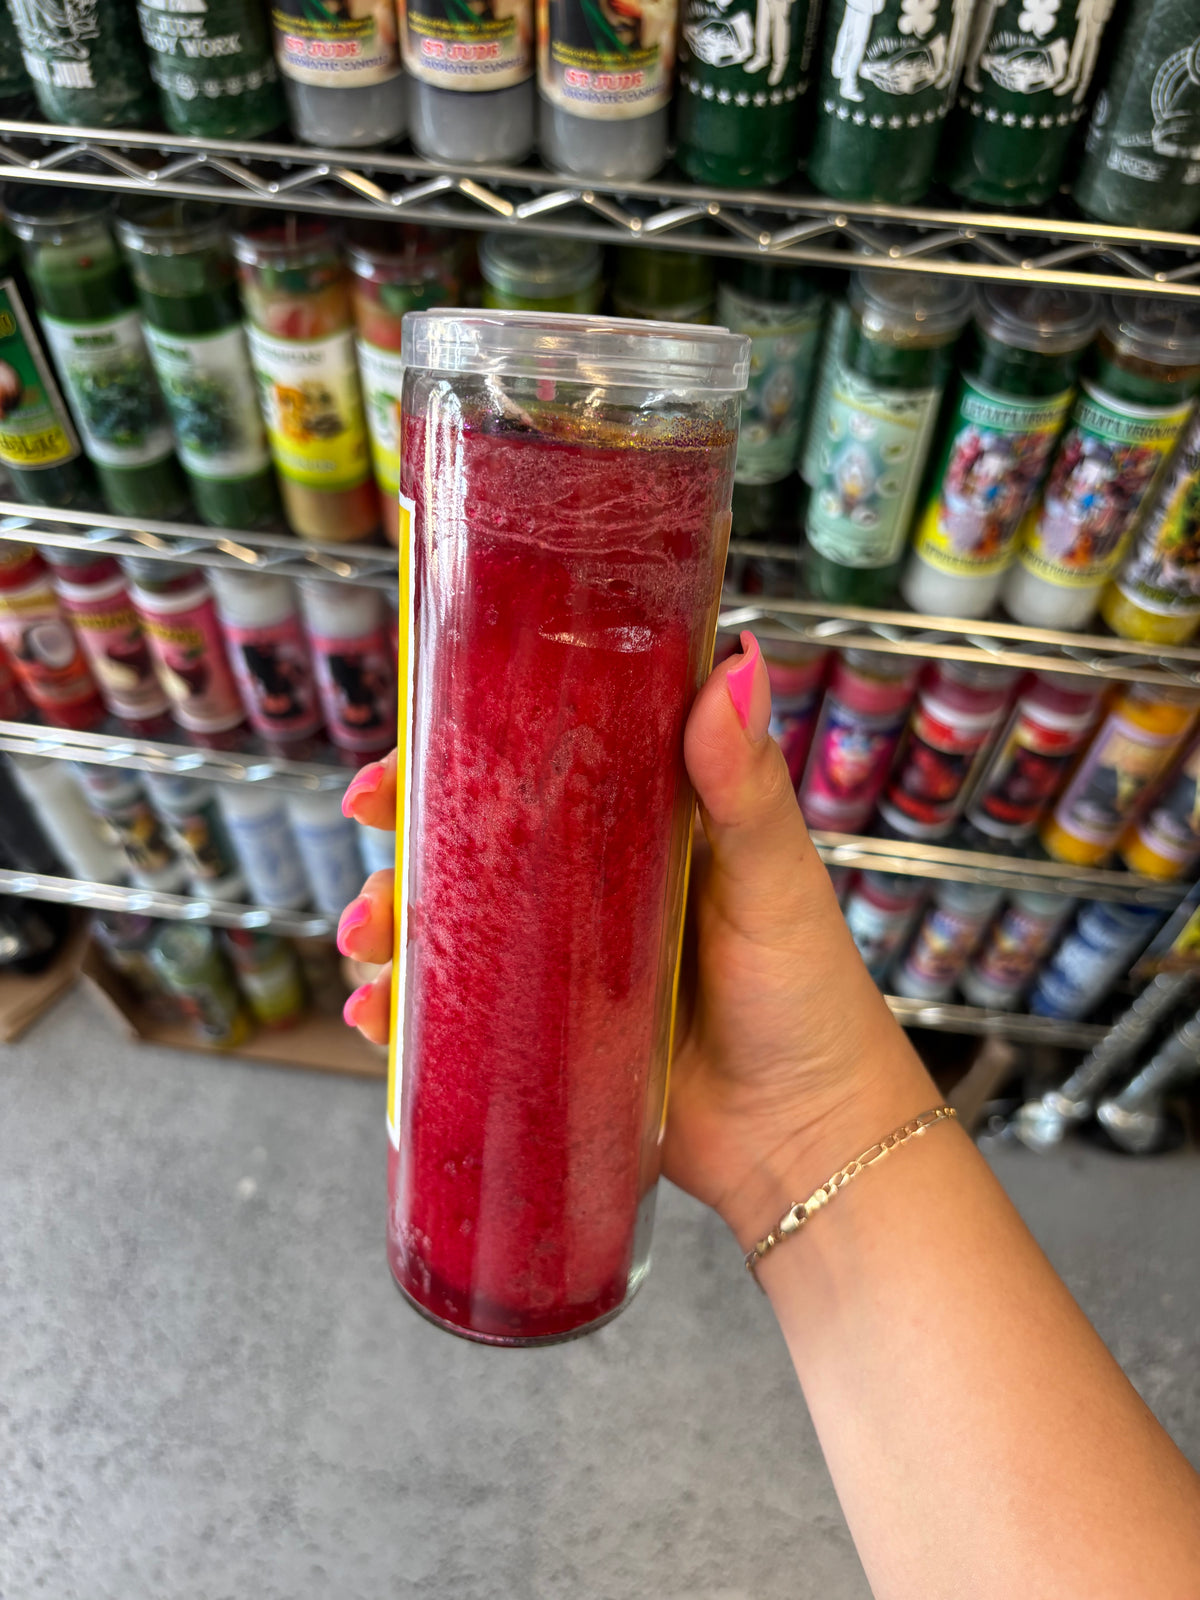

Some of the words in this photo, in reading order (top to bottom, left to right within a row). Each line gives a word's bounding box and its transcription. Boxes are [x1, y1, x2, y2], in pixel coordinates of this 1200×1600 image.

[157, 16, 207, 38] JUDE
[179, 33, 242, 58] WORK
[284, 35, 304, 56] ST
[306, 40, 361, 58] JUDE
[421, 38, 444, 57] ST
[446, 40, 502, 61] JUDE
[565, 68, 589, 88] ST
[592, 69, 647, 92] JUDE
